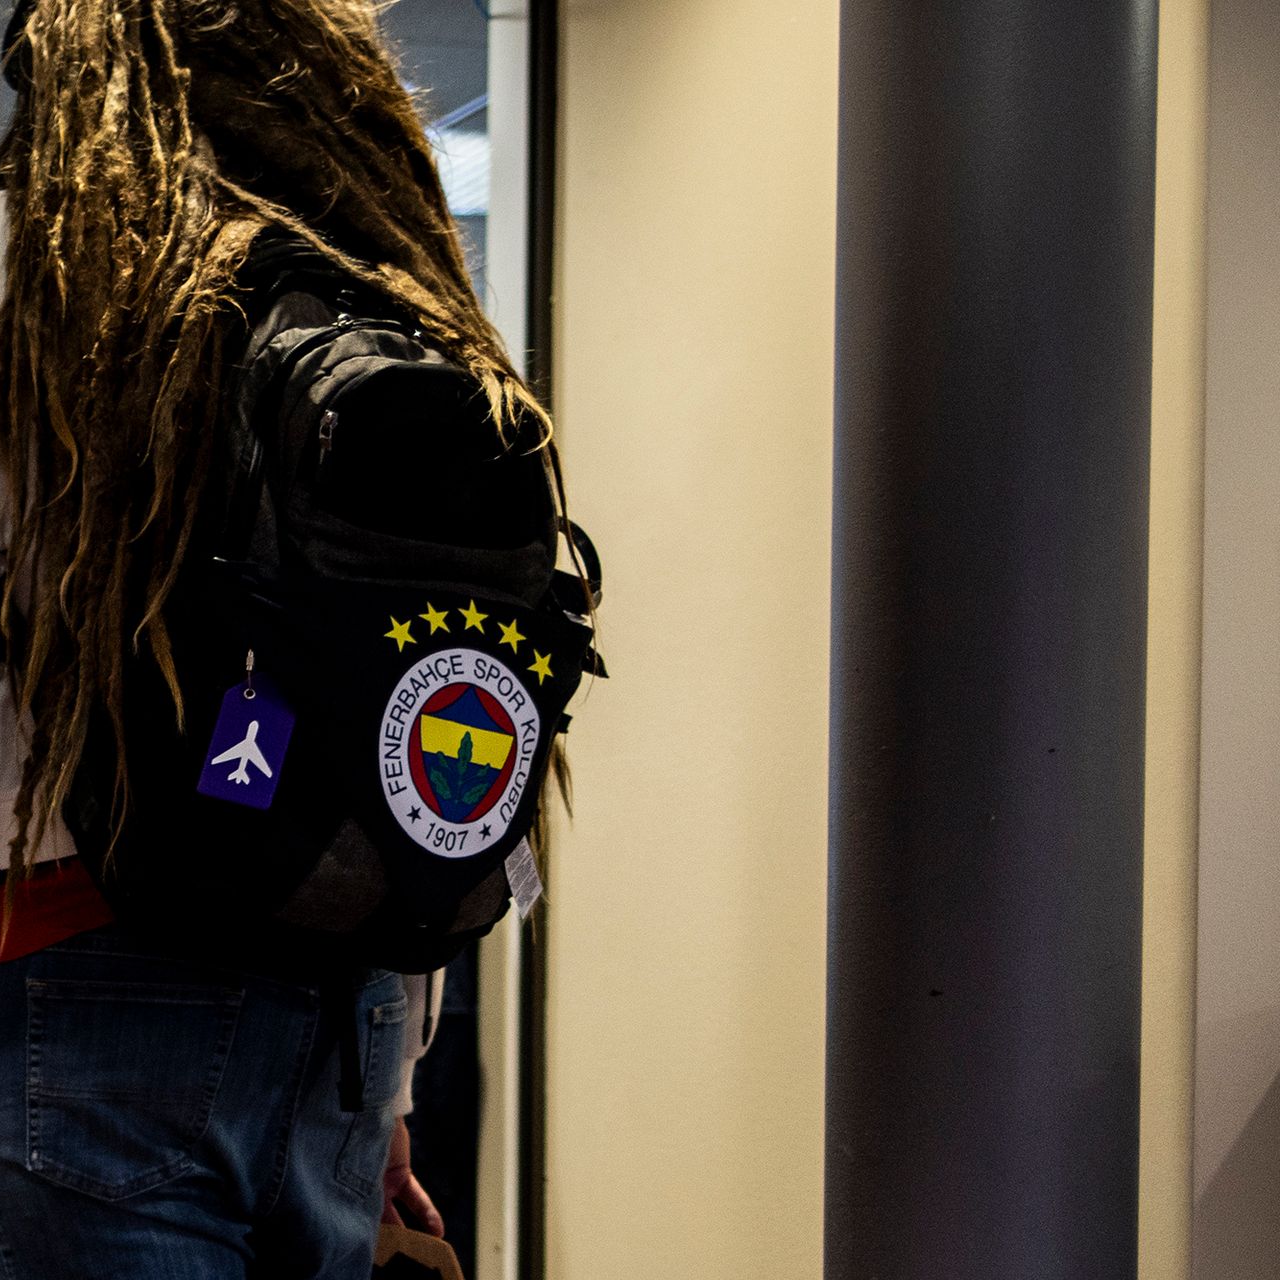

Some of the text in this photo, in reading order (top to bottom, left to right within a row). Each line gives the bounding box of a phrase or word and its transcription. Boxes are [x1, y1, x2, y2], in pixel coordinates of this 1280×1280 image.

[384, 655, 464, 796] FENERBAHÇE
[473, 658, 525, 713] SPOR
[425, 823, 469, 851] 1907
